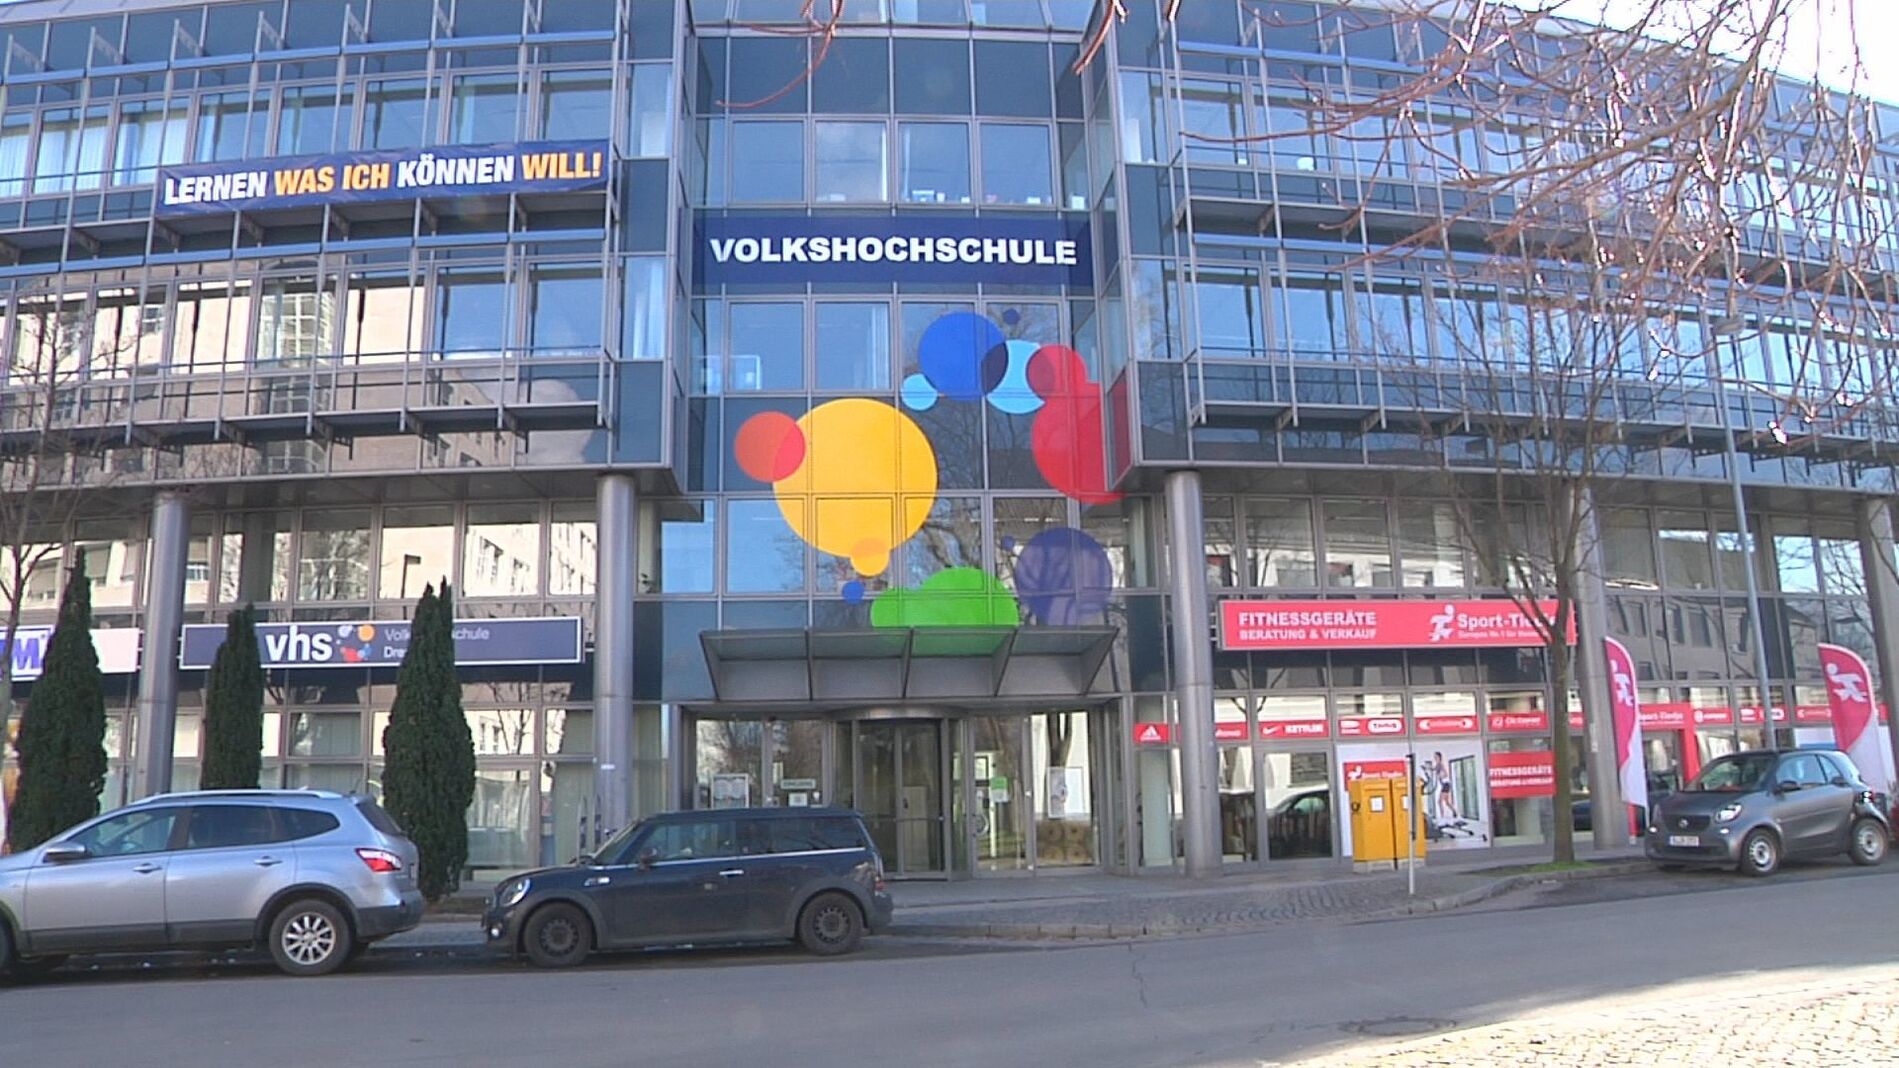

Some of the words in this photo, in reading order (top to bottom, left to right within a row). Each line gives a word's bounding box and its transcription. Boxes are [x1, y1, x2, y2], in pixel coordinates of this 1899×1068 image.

[164, 171, 269, 206] LERNEN
[274, 165, 336, 197] WAS
[342, 162, 390, 191] ICH
[397, 153, 515, 188] KÖNNEN
[521, 152, 602, 181] WILL!
[709, 236, 1077, 265] VOLKSHOCHSCHULE
[1239, 609, 1377, 626] FITNESSGERÄTE
[265, 625, 332, 661] vhs
[1240, 629, 1305, 640] BERATUNG
[1309, 629, 1319, 639] &
[1321, 628, 1376, 640] VERKAUF
